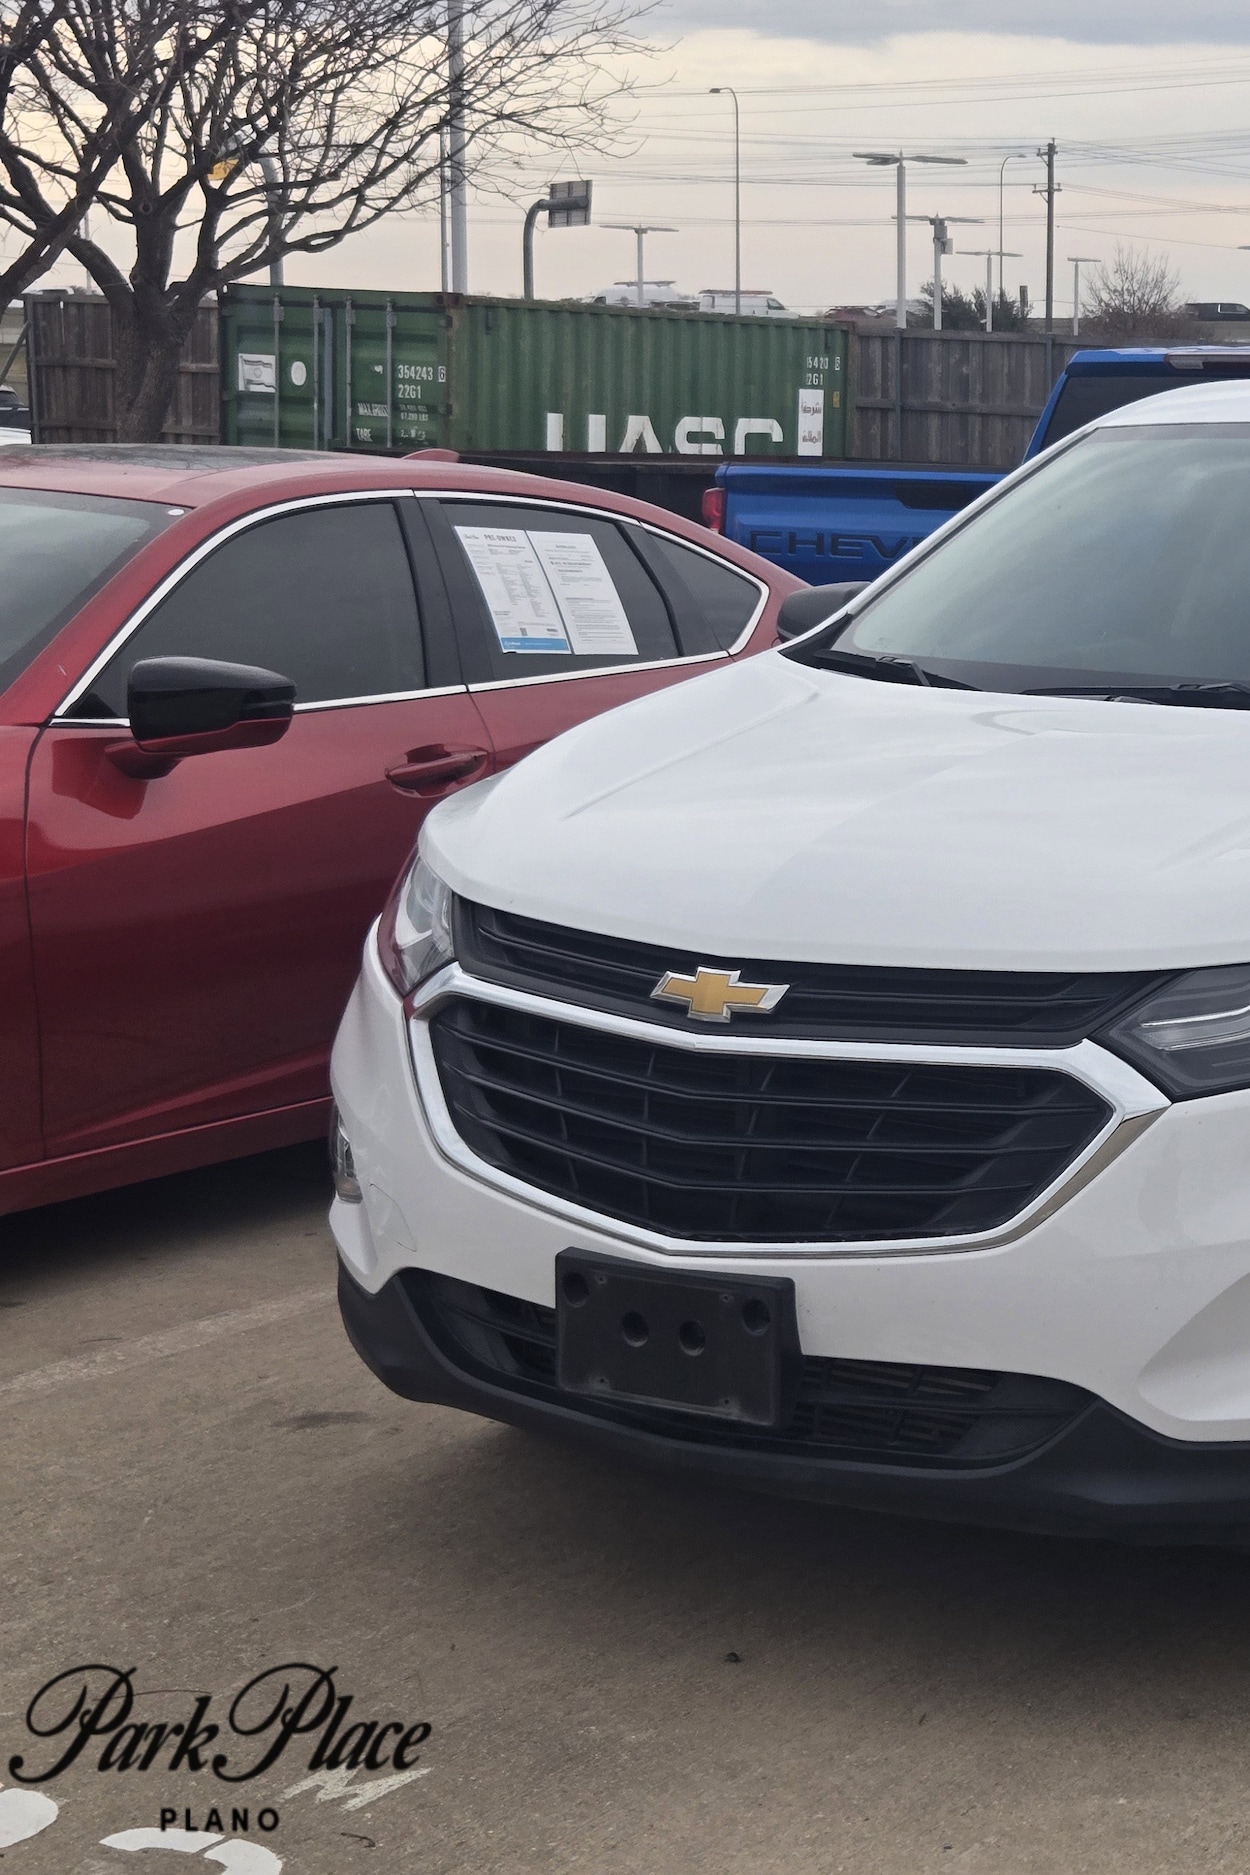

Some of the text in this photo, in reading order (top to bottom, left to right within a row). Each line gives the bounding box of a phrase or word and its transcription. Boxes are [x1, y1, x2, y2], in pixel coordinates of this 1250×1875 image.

[398, 365, 446, 382] 354243 6
[398, 385, 421, 399] 22G1
[749, 530, 926, 560] CHEV
